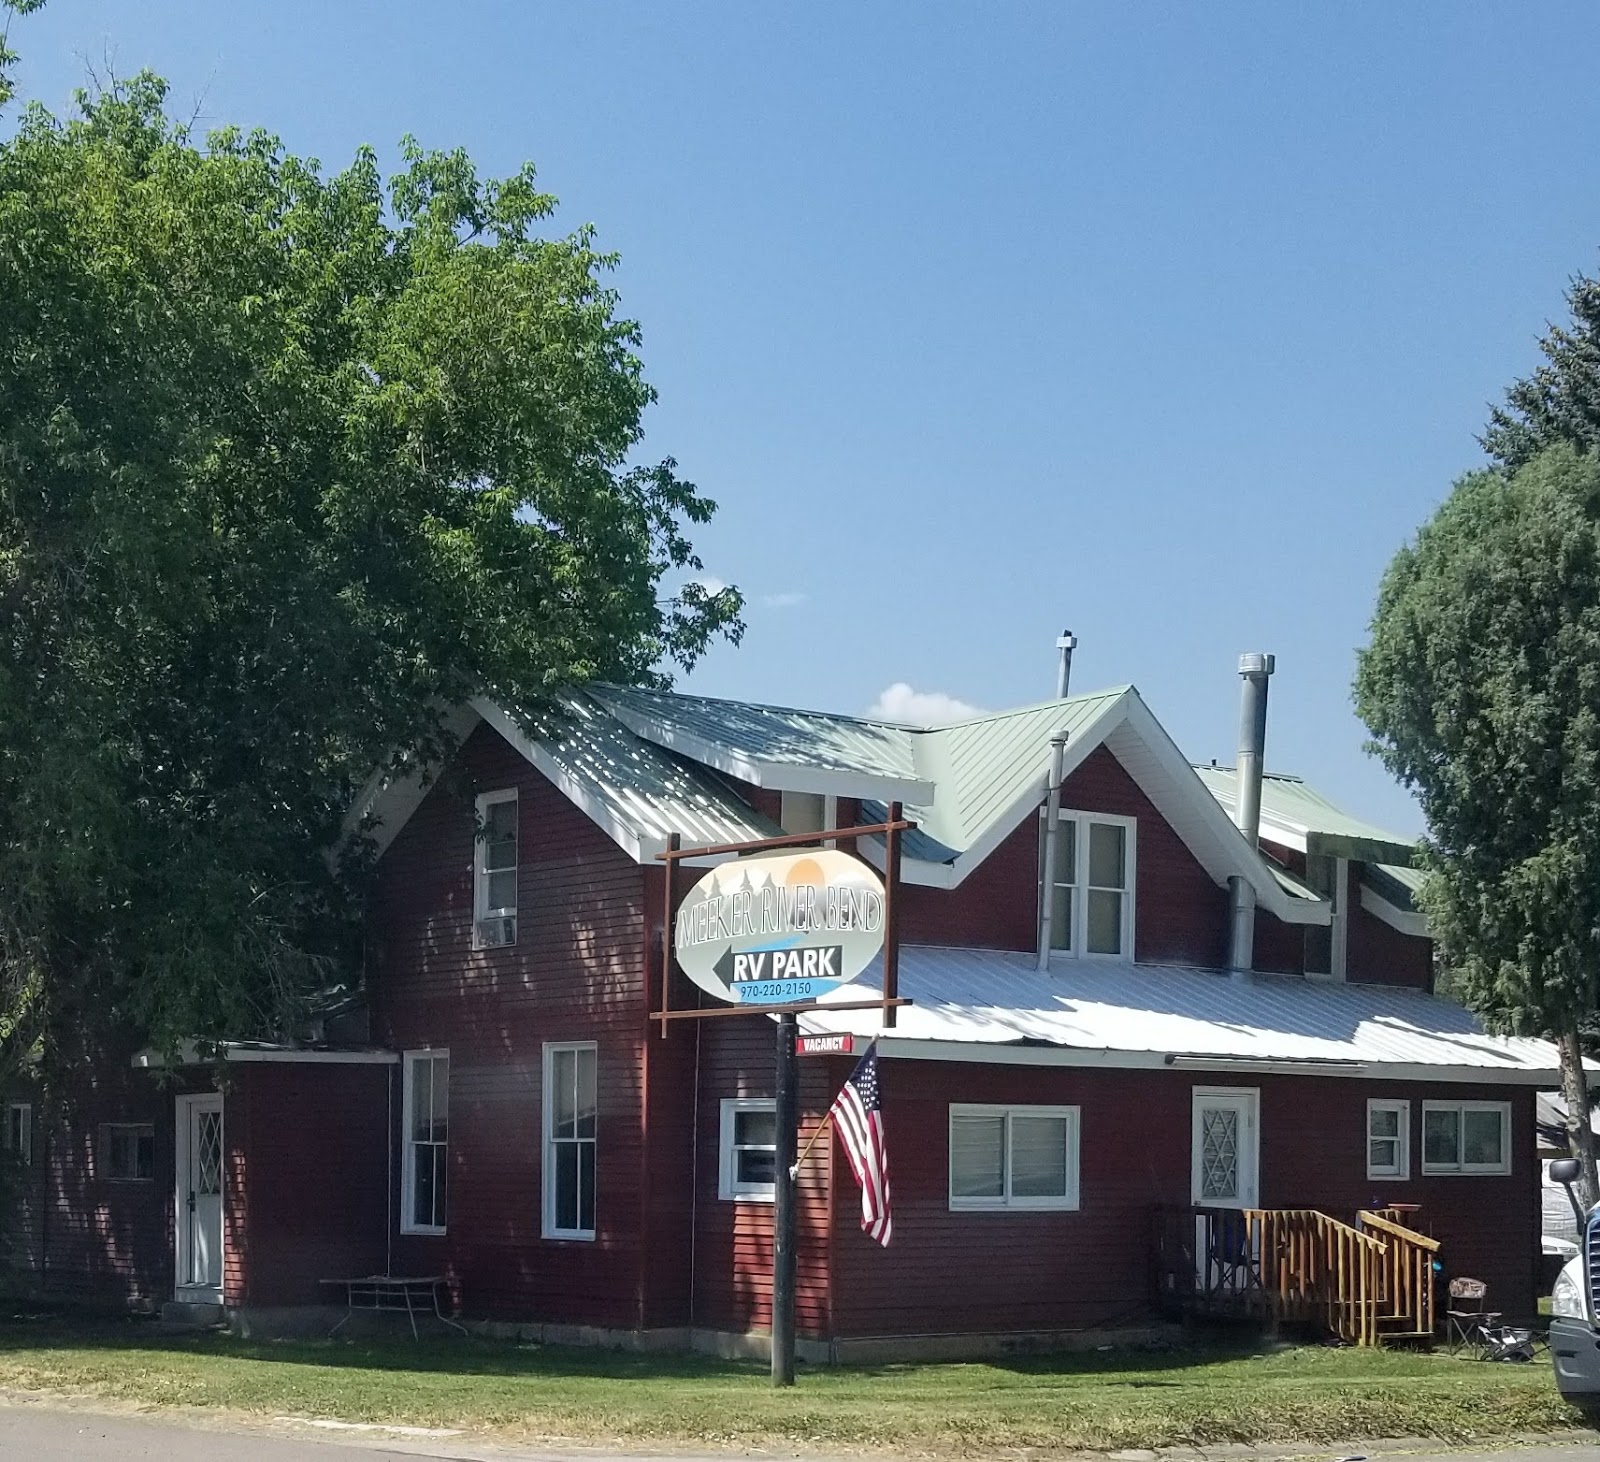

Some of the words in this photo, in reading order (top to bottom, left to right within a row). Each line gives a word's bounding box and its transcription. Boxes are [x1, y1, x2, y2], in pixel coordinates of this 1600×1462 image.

[678, 890, 757, 949] MEEKER
[760, 885, 821, 934] RIVER
[824, 885, 883, 933] BEND
[733, 952, 766, 982] RV
[772, 947, 836, 979] PARK
[741, 982, 811, 998] 970-220-2150
[803, 1036, 845, 1052] VACANCY
